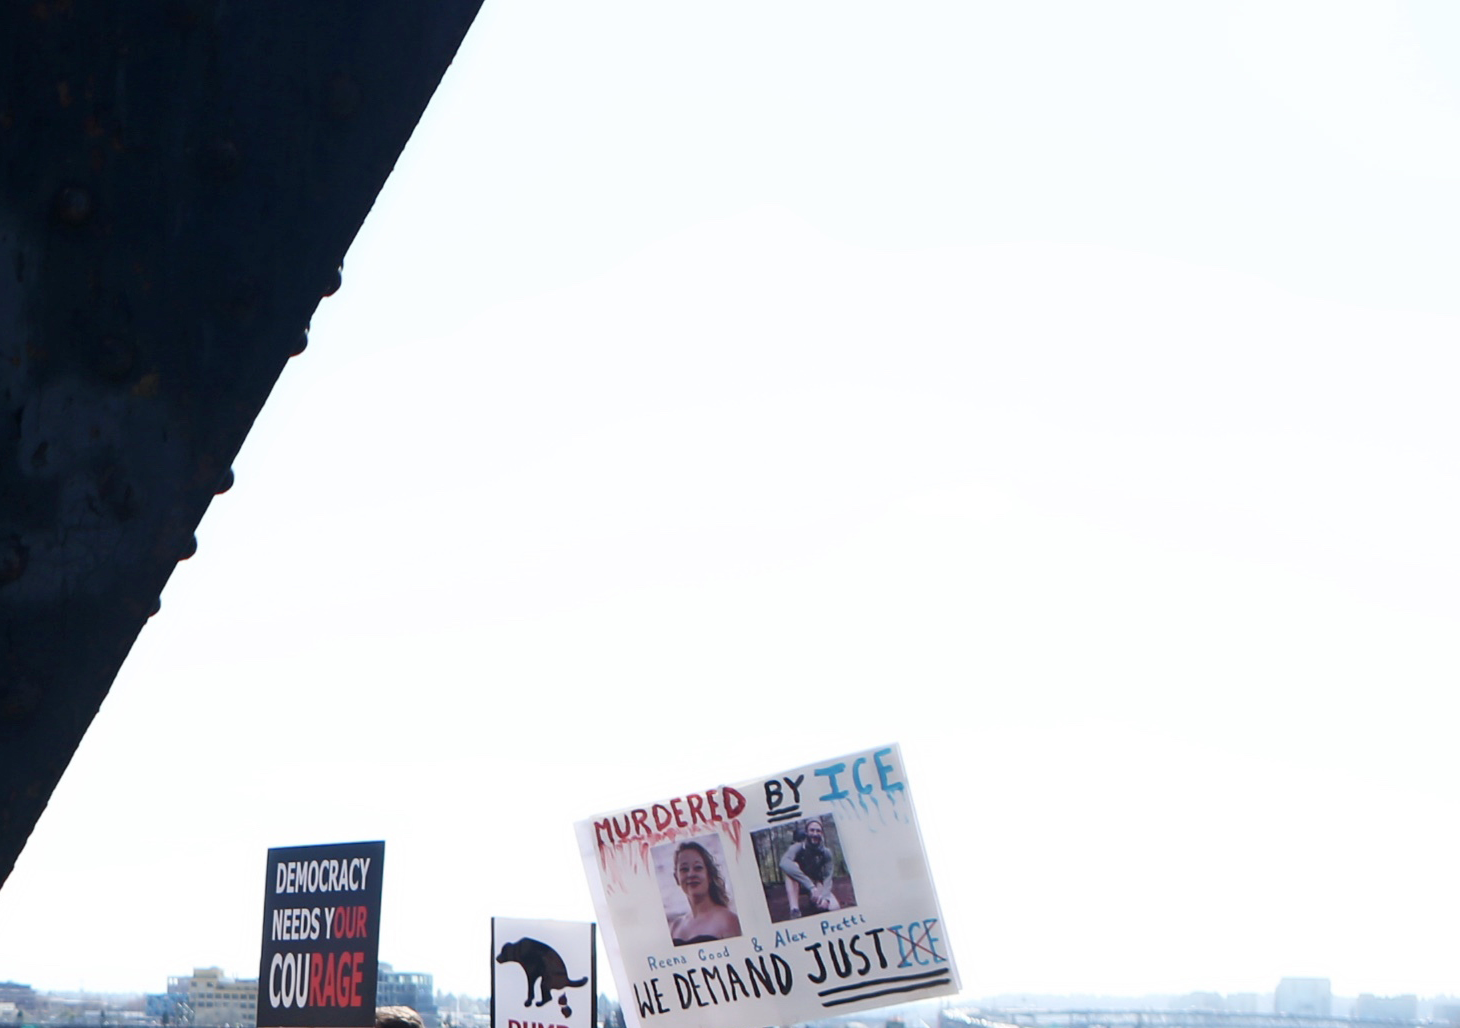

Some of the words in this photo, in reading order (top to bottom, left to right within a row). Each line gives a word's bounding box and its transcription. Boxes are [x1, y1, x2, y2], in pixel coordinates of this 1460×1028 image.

[594, 786, 747, 846] MURDERED
[763, 774, 805, 809] BY
[814, 747, 904, 802] ICE
[275, 857, 371, 895] DEMOCRACY
[272, 907, 320, 941] NEEDS
[324, 905, 368, 939] YOUR
[774, 929, 808, 949] Alex
[820, 914, 867, 936] Pretti
[268, 951, 365, 1009] COURAGE
[633, 981, 671, 1019] WE
[673, 953, 794, 1011] DEMAND
[804, 918, 947, 984] JUSTICE
